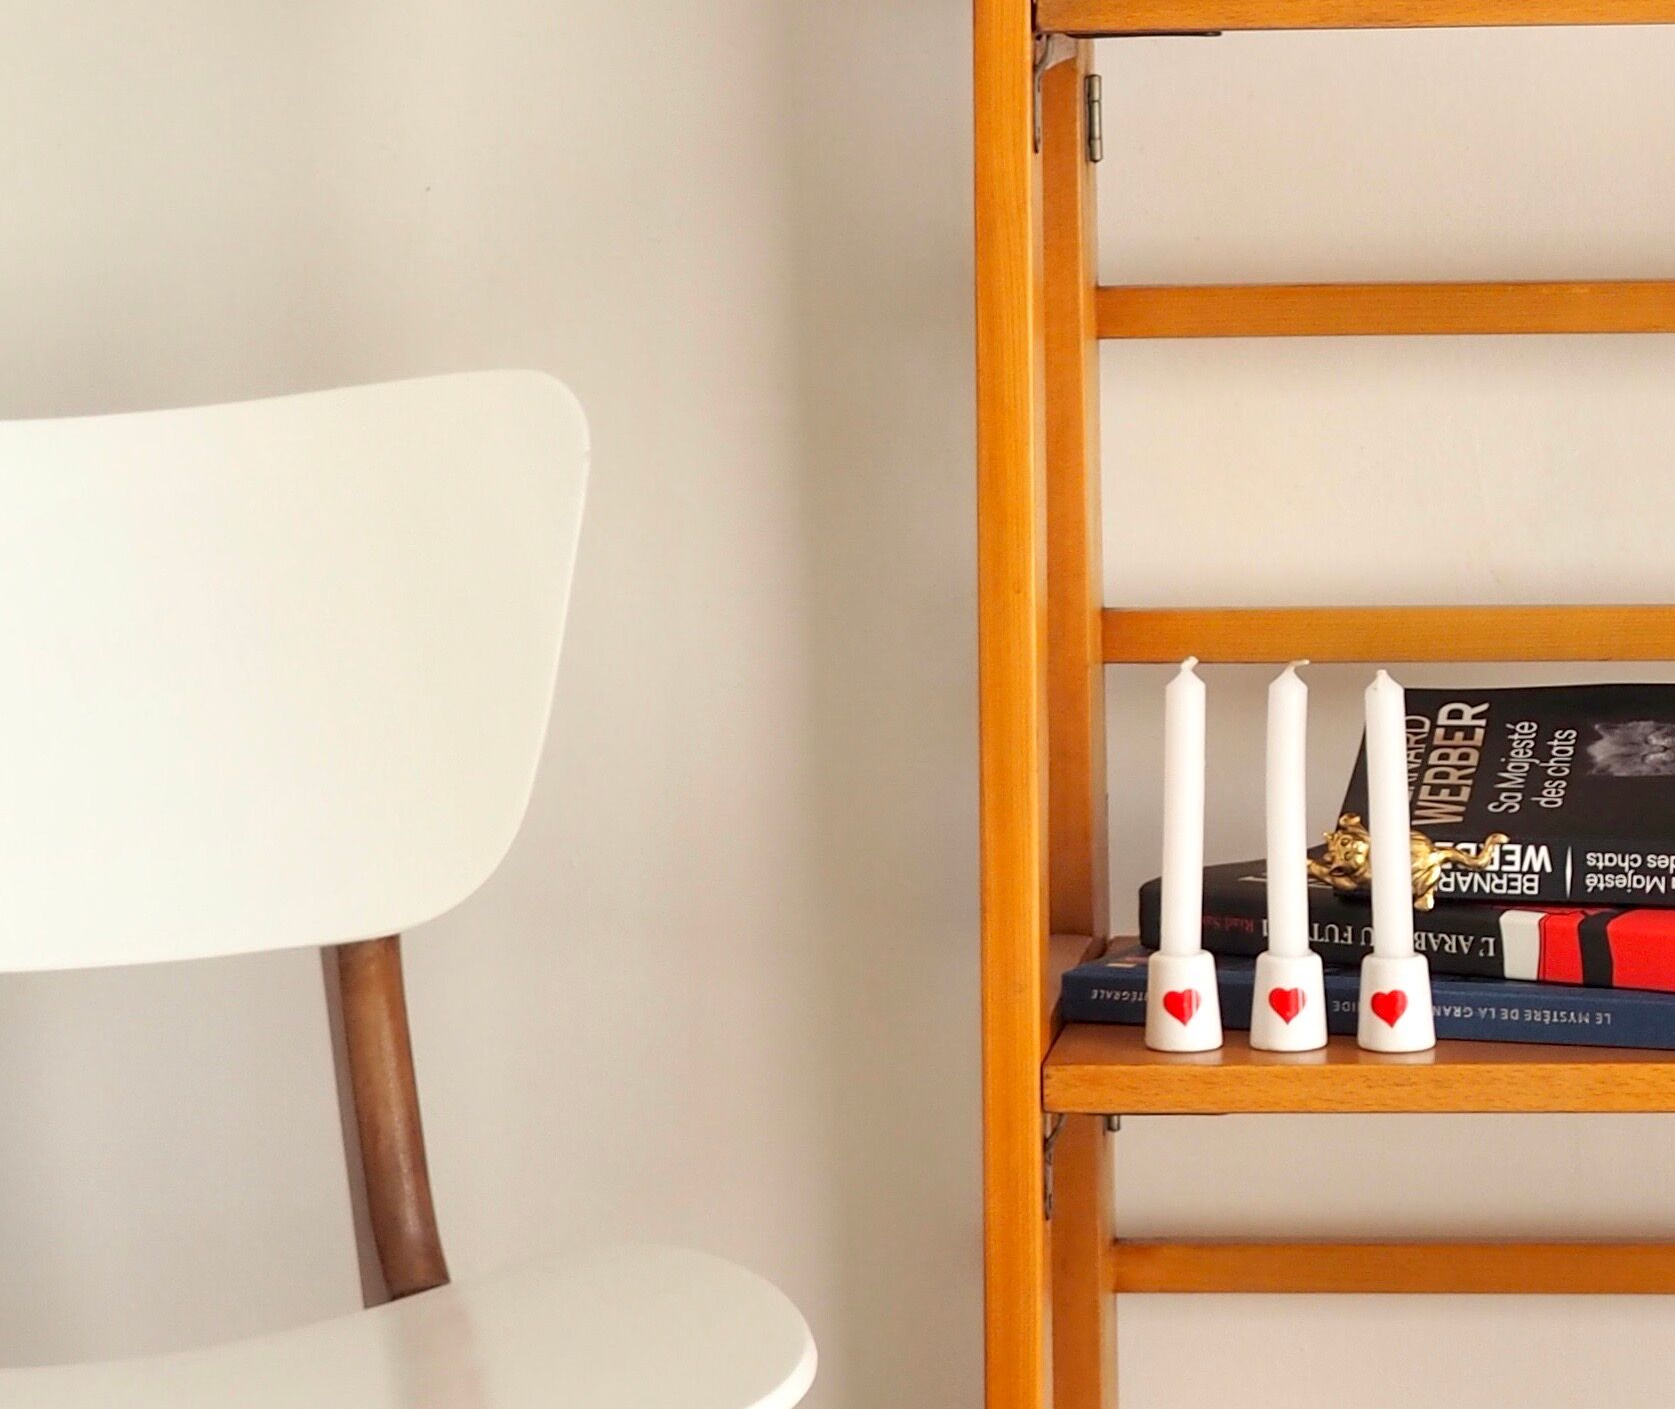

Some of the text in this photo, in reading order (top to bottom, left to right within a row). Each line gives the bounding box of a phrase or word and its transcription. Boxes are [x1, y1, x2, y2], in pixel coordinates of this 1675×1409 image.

[1410, 701, 1490, 826] WERBER
[1487, 720, 1541, 814] Sa Majesté
[1530, 728, 1577, 809] des chats
[1585, 852, 1642, 871] chats
[1434, 871, 1540, 895] BERNAR
[1585, 870, 1667, 895] Majesté
[1309, 922, 1353, 945] FUT
[1414, 931, 1475, 954] ARAB
[1433, 1005, 1612, 1024] LE MYSTÈRE DE LA GRAN
